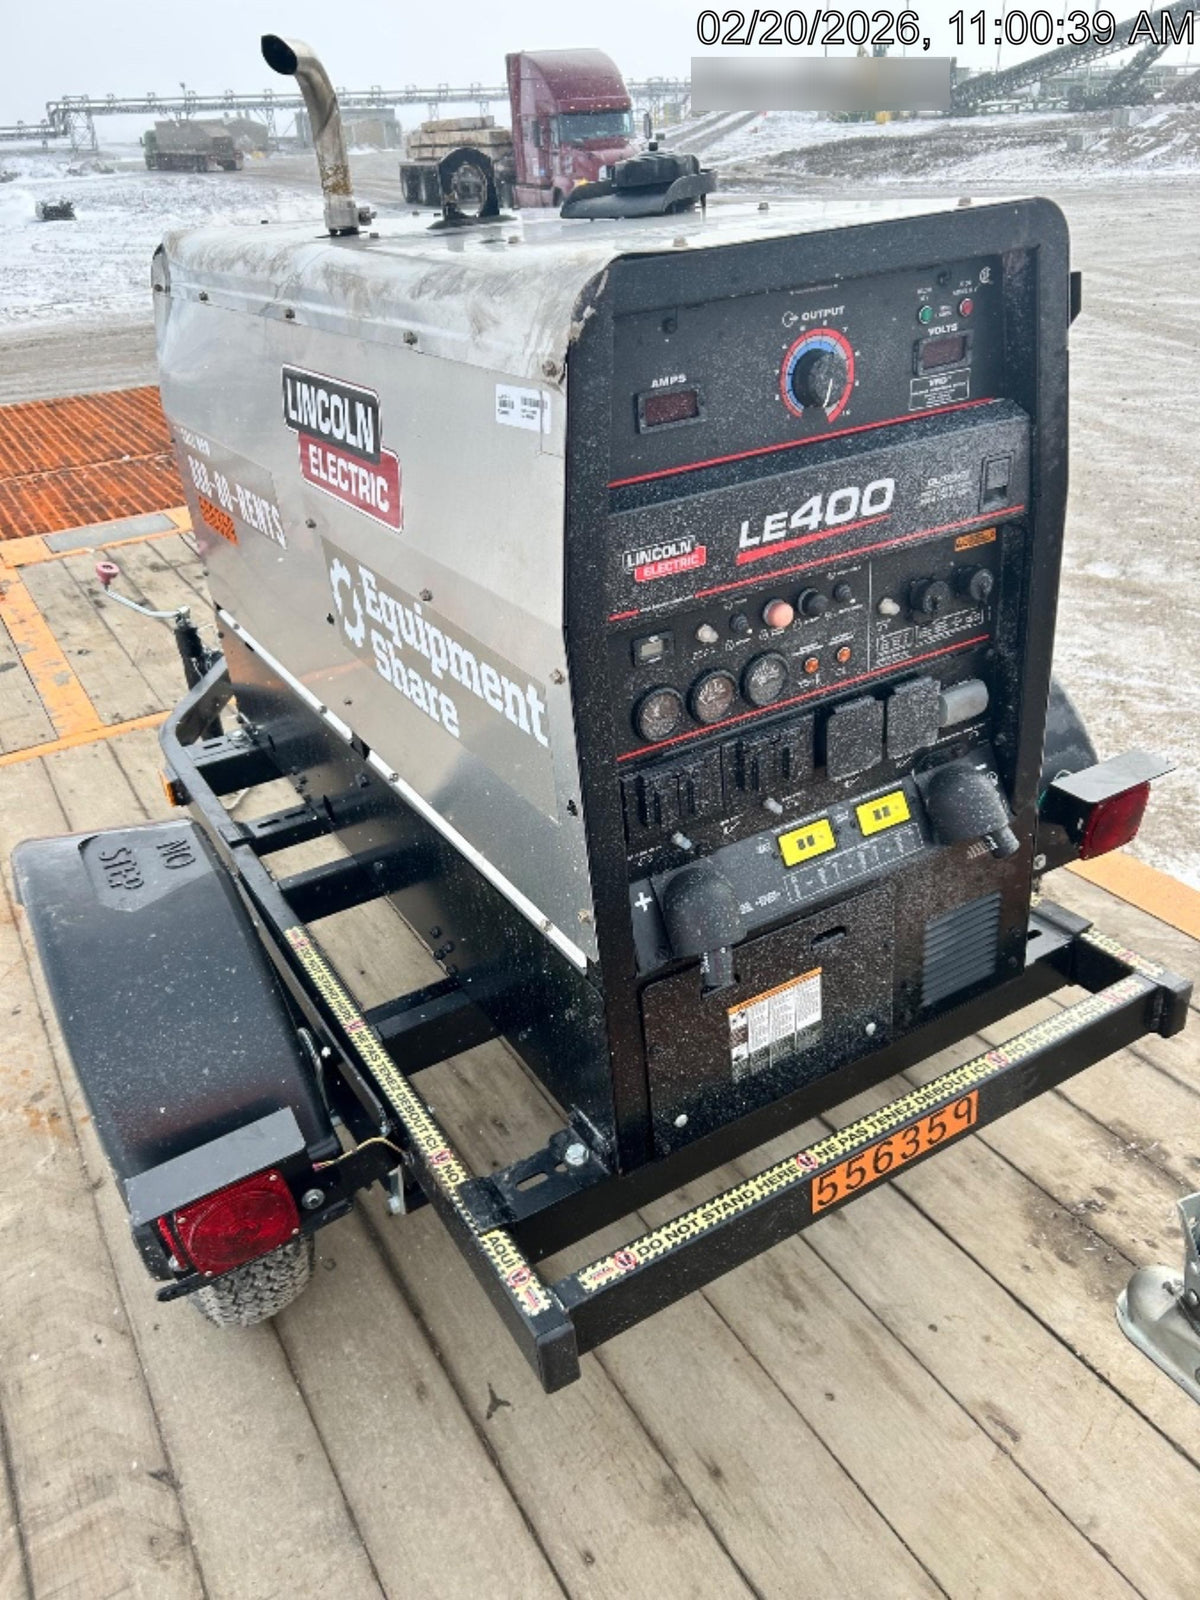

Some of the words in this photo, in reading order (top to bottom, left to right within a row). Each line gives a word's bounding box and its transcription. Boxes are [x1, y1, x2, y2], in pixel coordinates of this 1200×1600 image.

[801, 305, 845, 321] OUTPUT
[927, 323, 958, 336] VOLTS
[286, 377, 375, 454] LINCOLN
[650, 373, 688, 389] AMPS
[308, 443, 390, 513] ELECTRIC
[738, 477, 895, 549] LE400
[626, 540, 692, 567] LINCOLN
[643, 553, 699, 577] ELECTRIC
[358, 564, 549, 748] Equipment
[371, 628, 460, 738] Share
[156, 839, 196, 870] NO
[364, 1043, 381, 1063] PAS
[395, 1091, 429, 1133] DEBOUT
[442, 1163, 460, 1184] NO
[636, 1238, 663, 1257] DO
[665, 1219, 700, 1242] NOT
[703, 1188, 756, 1222] STAND
[757, 1164, 799, 1192] HERE
[816, 1140, 837, 1159] NE
[839, 1126, 869, 1148] PAS
[870, 1101, 914, 1131] TENEZ
[913, 1073, 968, 1106] DEBOUT
[969, 1062, 992, 1081] ICI
[817, 1096, 974, 1207] 556359
